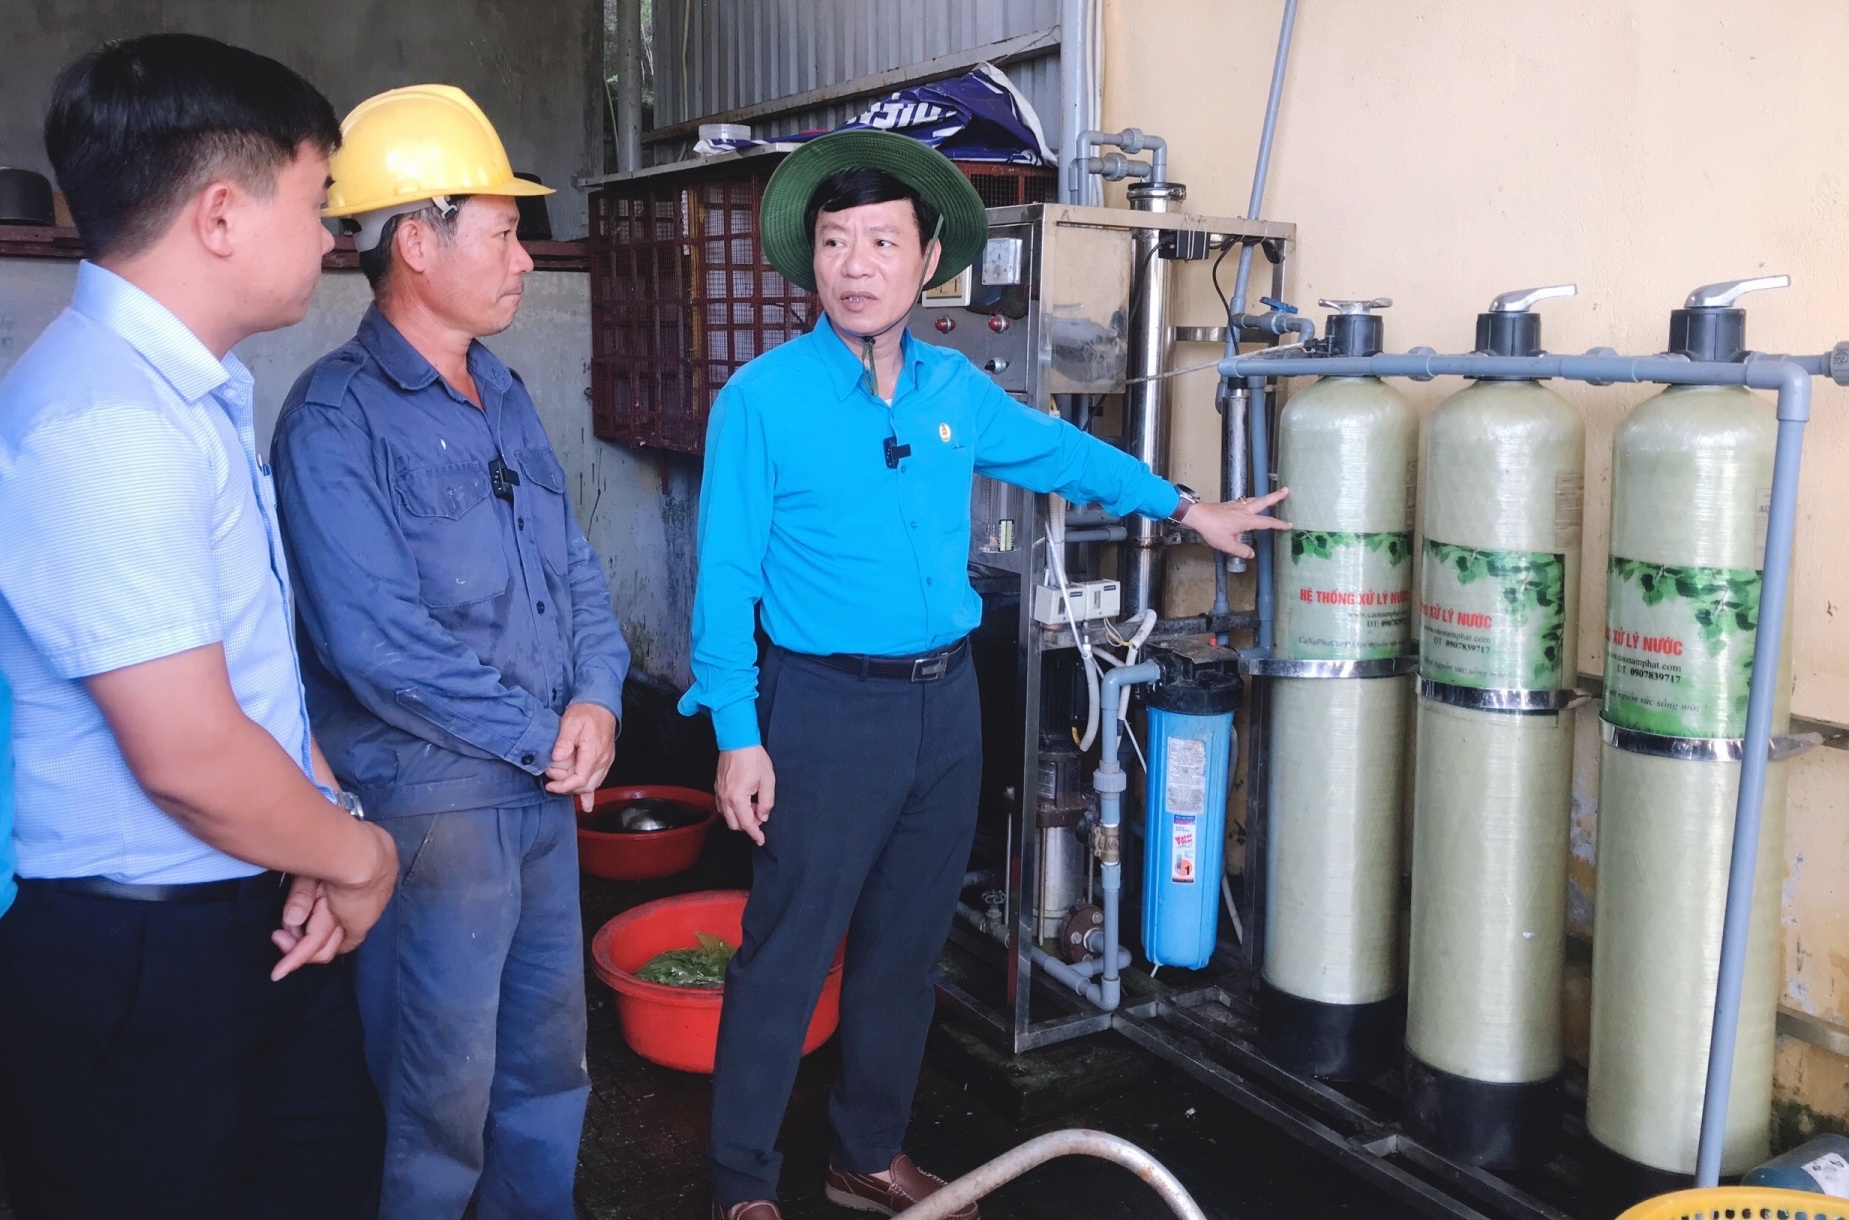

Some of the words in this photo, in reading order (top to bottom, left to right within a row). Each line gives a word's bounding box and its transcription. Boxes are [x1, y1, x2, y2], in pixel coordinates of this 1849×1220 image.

[1300, 587, 1312, 605] HỆ
[1316, 588, 1355, 605] THỐNG
[1358, 588, 1375, 606] XỬ
[1377, 589, 1388, 605] LÝ
[1429, 603, 1441, 621] XỬ
[1442, 608, 1454, 623] LÝ
[1457, 611, 1493, 630] NƯỚC
[1445, 640, 1491, 654] 0907839717
[1613, 627, 1625, 645] XỬ
[1626, 631, 1640, 649] LÝ
[1643, 635, 1684, 656] NƯỚC
[1630, 667, 1681, 684] 0907839717
